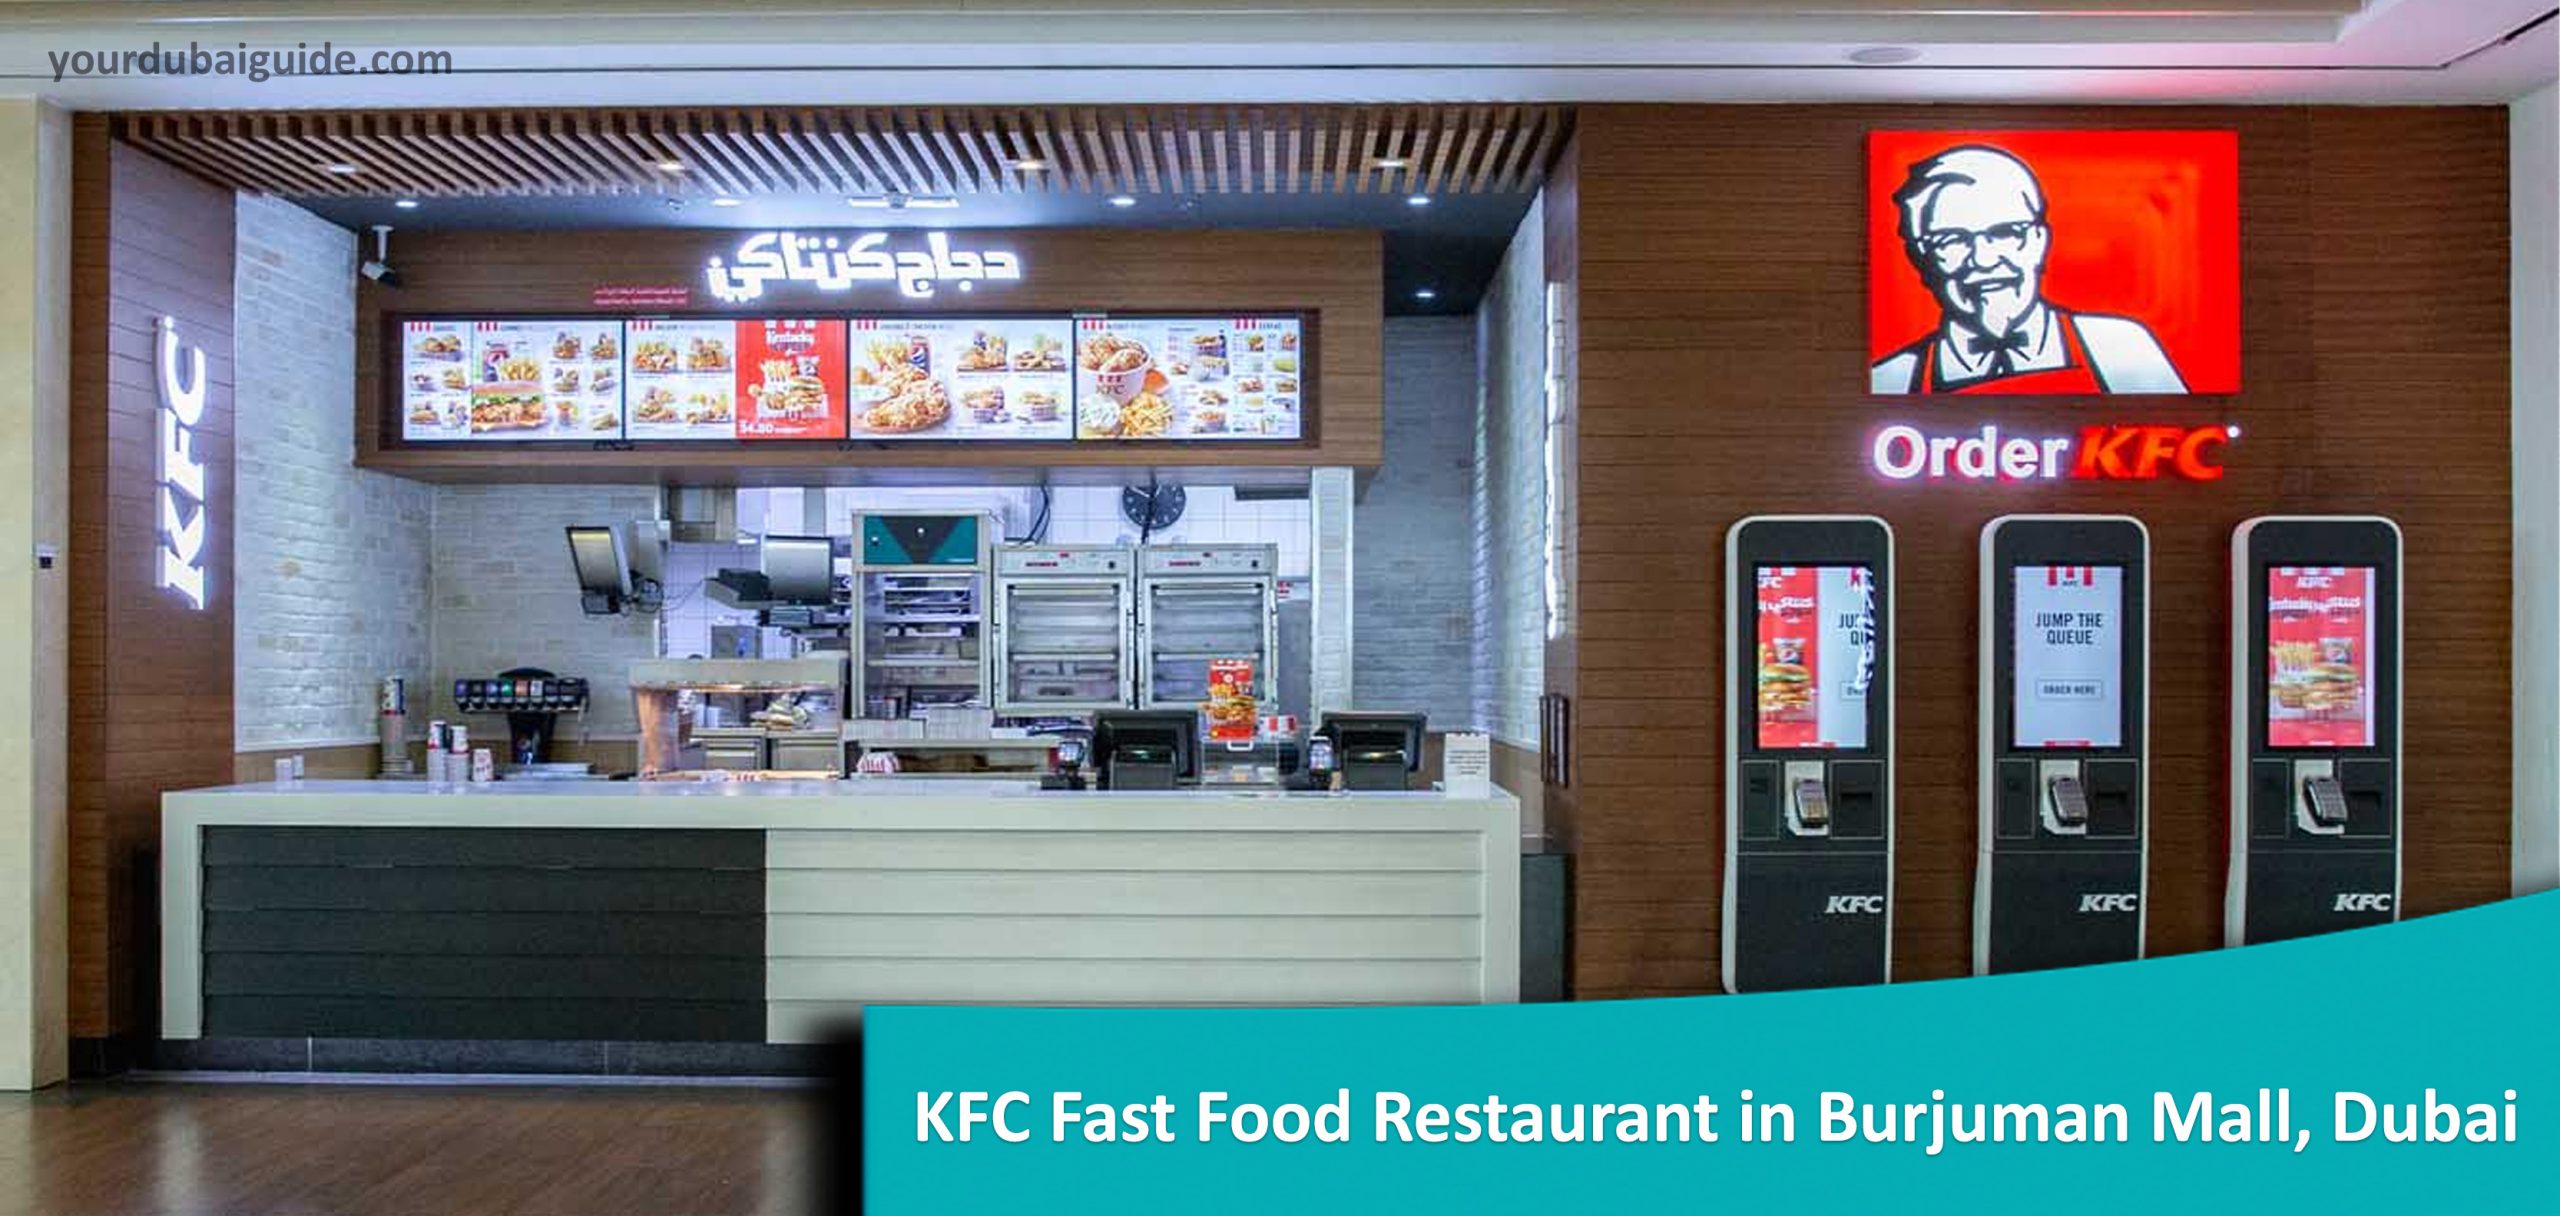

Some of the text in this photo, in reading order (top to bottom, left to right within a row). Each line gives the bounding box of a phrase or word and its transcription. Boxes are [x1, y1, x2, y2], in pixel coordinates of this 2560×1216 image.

[896, 232, 1020, 298] دجاج
[1873, 425, 2229, 480] Order KFC
[158, 326, 206, 610] KFC
[2035, 613, 2104, 629] JUMP THE
[2046, 630, 2095, 645] QUEUE
[2043, 684, 2097, 695] ORDER HERE
[1825, 896, 1884, 913] KFC
[2079, 894, 2138, 911] KFC
[2334, 893, 2391, 911] KFC
